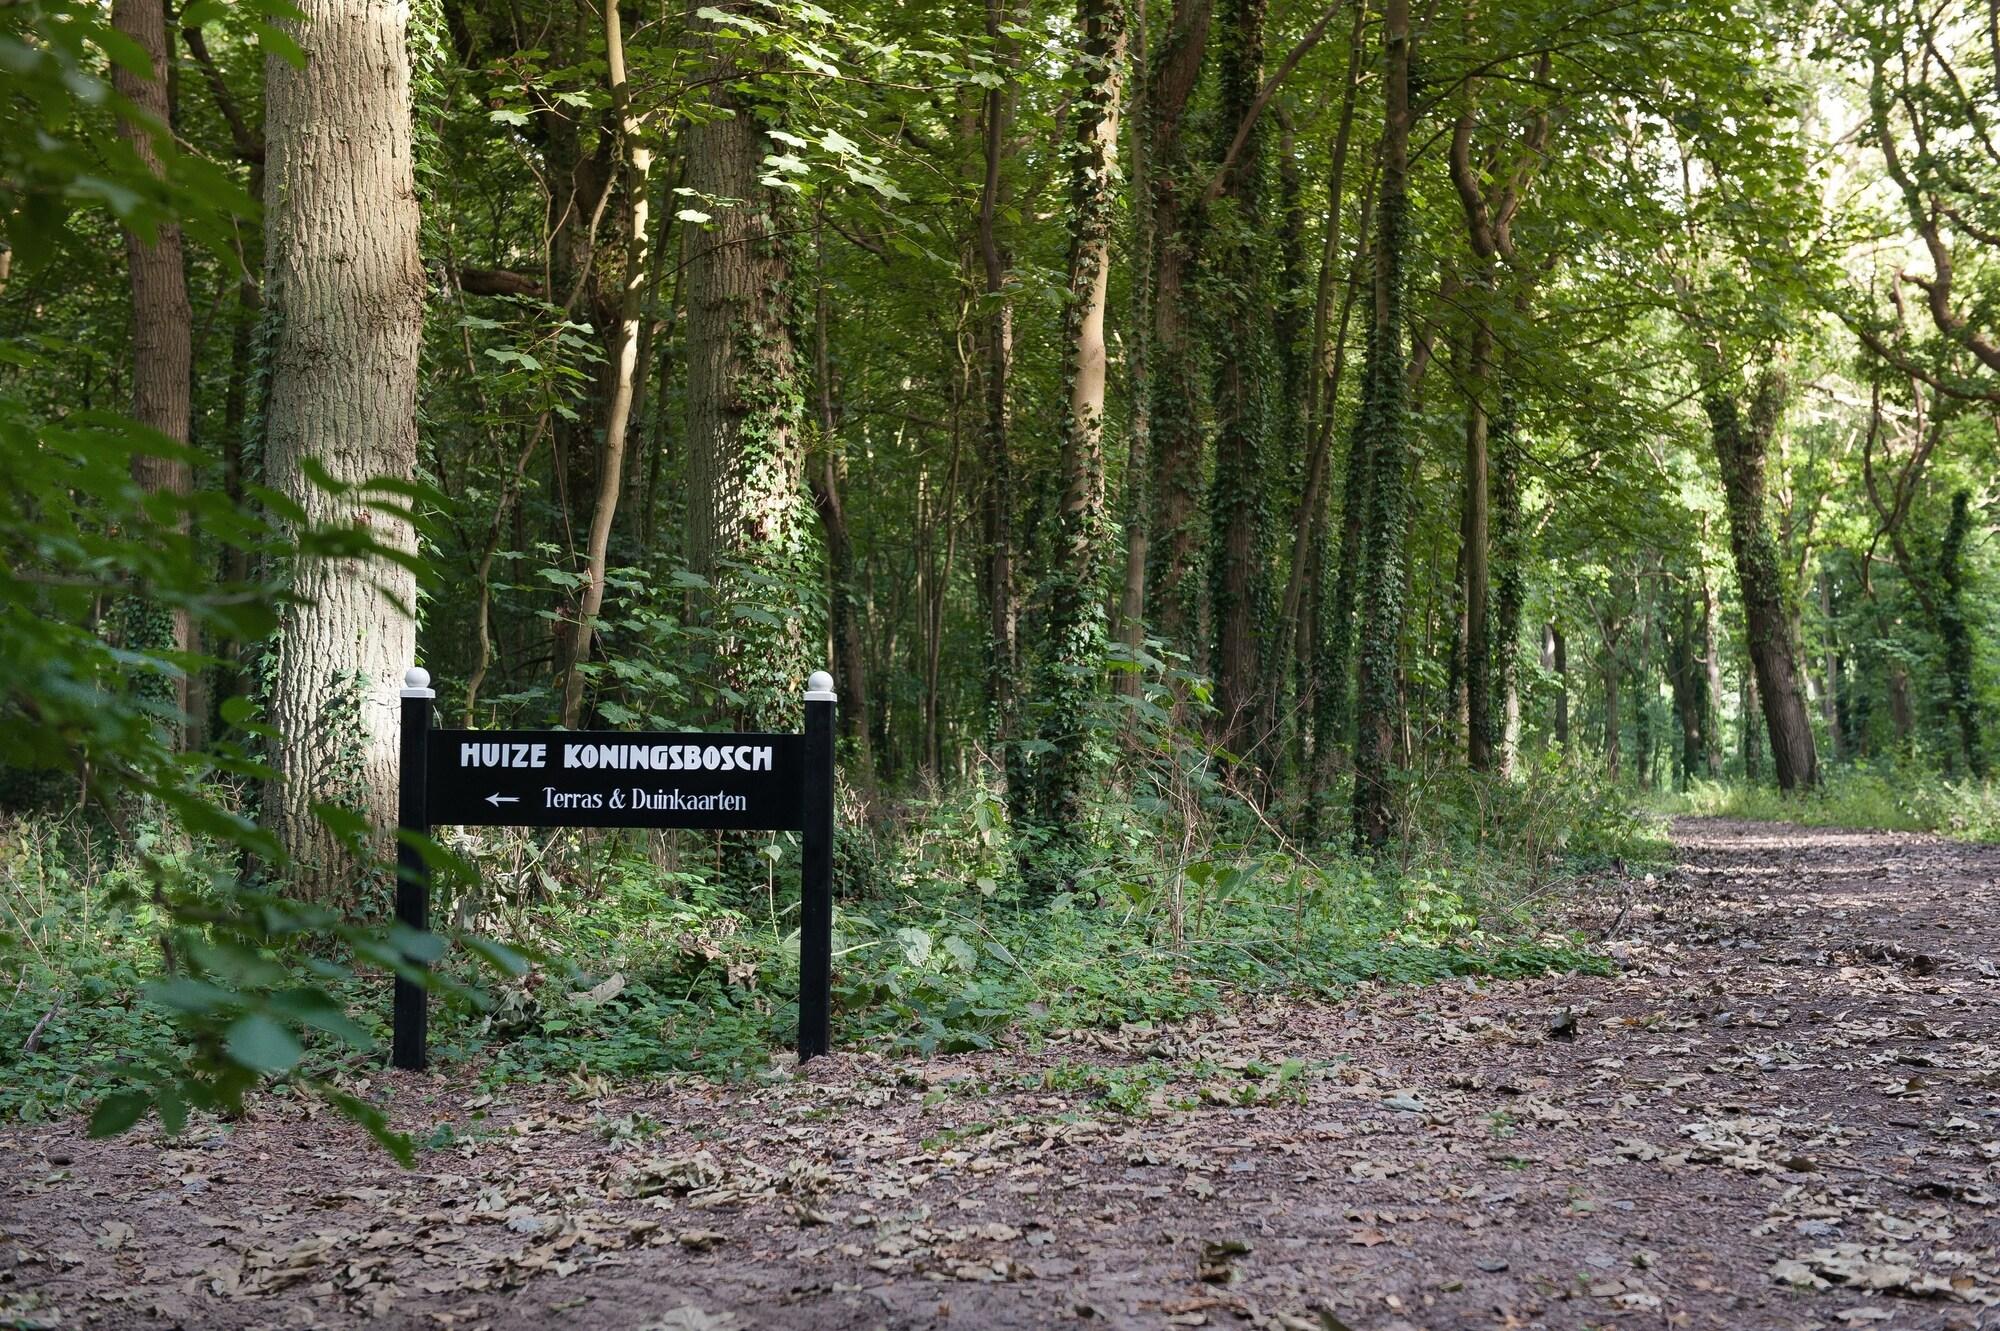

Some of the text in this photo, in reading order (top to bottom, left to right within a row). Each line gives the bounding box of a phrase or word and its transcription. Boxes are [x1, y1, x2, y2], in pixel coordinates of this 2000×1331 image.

[460, 743, 773, 770] HUIZE KONINGSBOSCH
[542, 786, 747, 811] Terras & Duinkaarten
